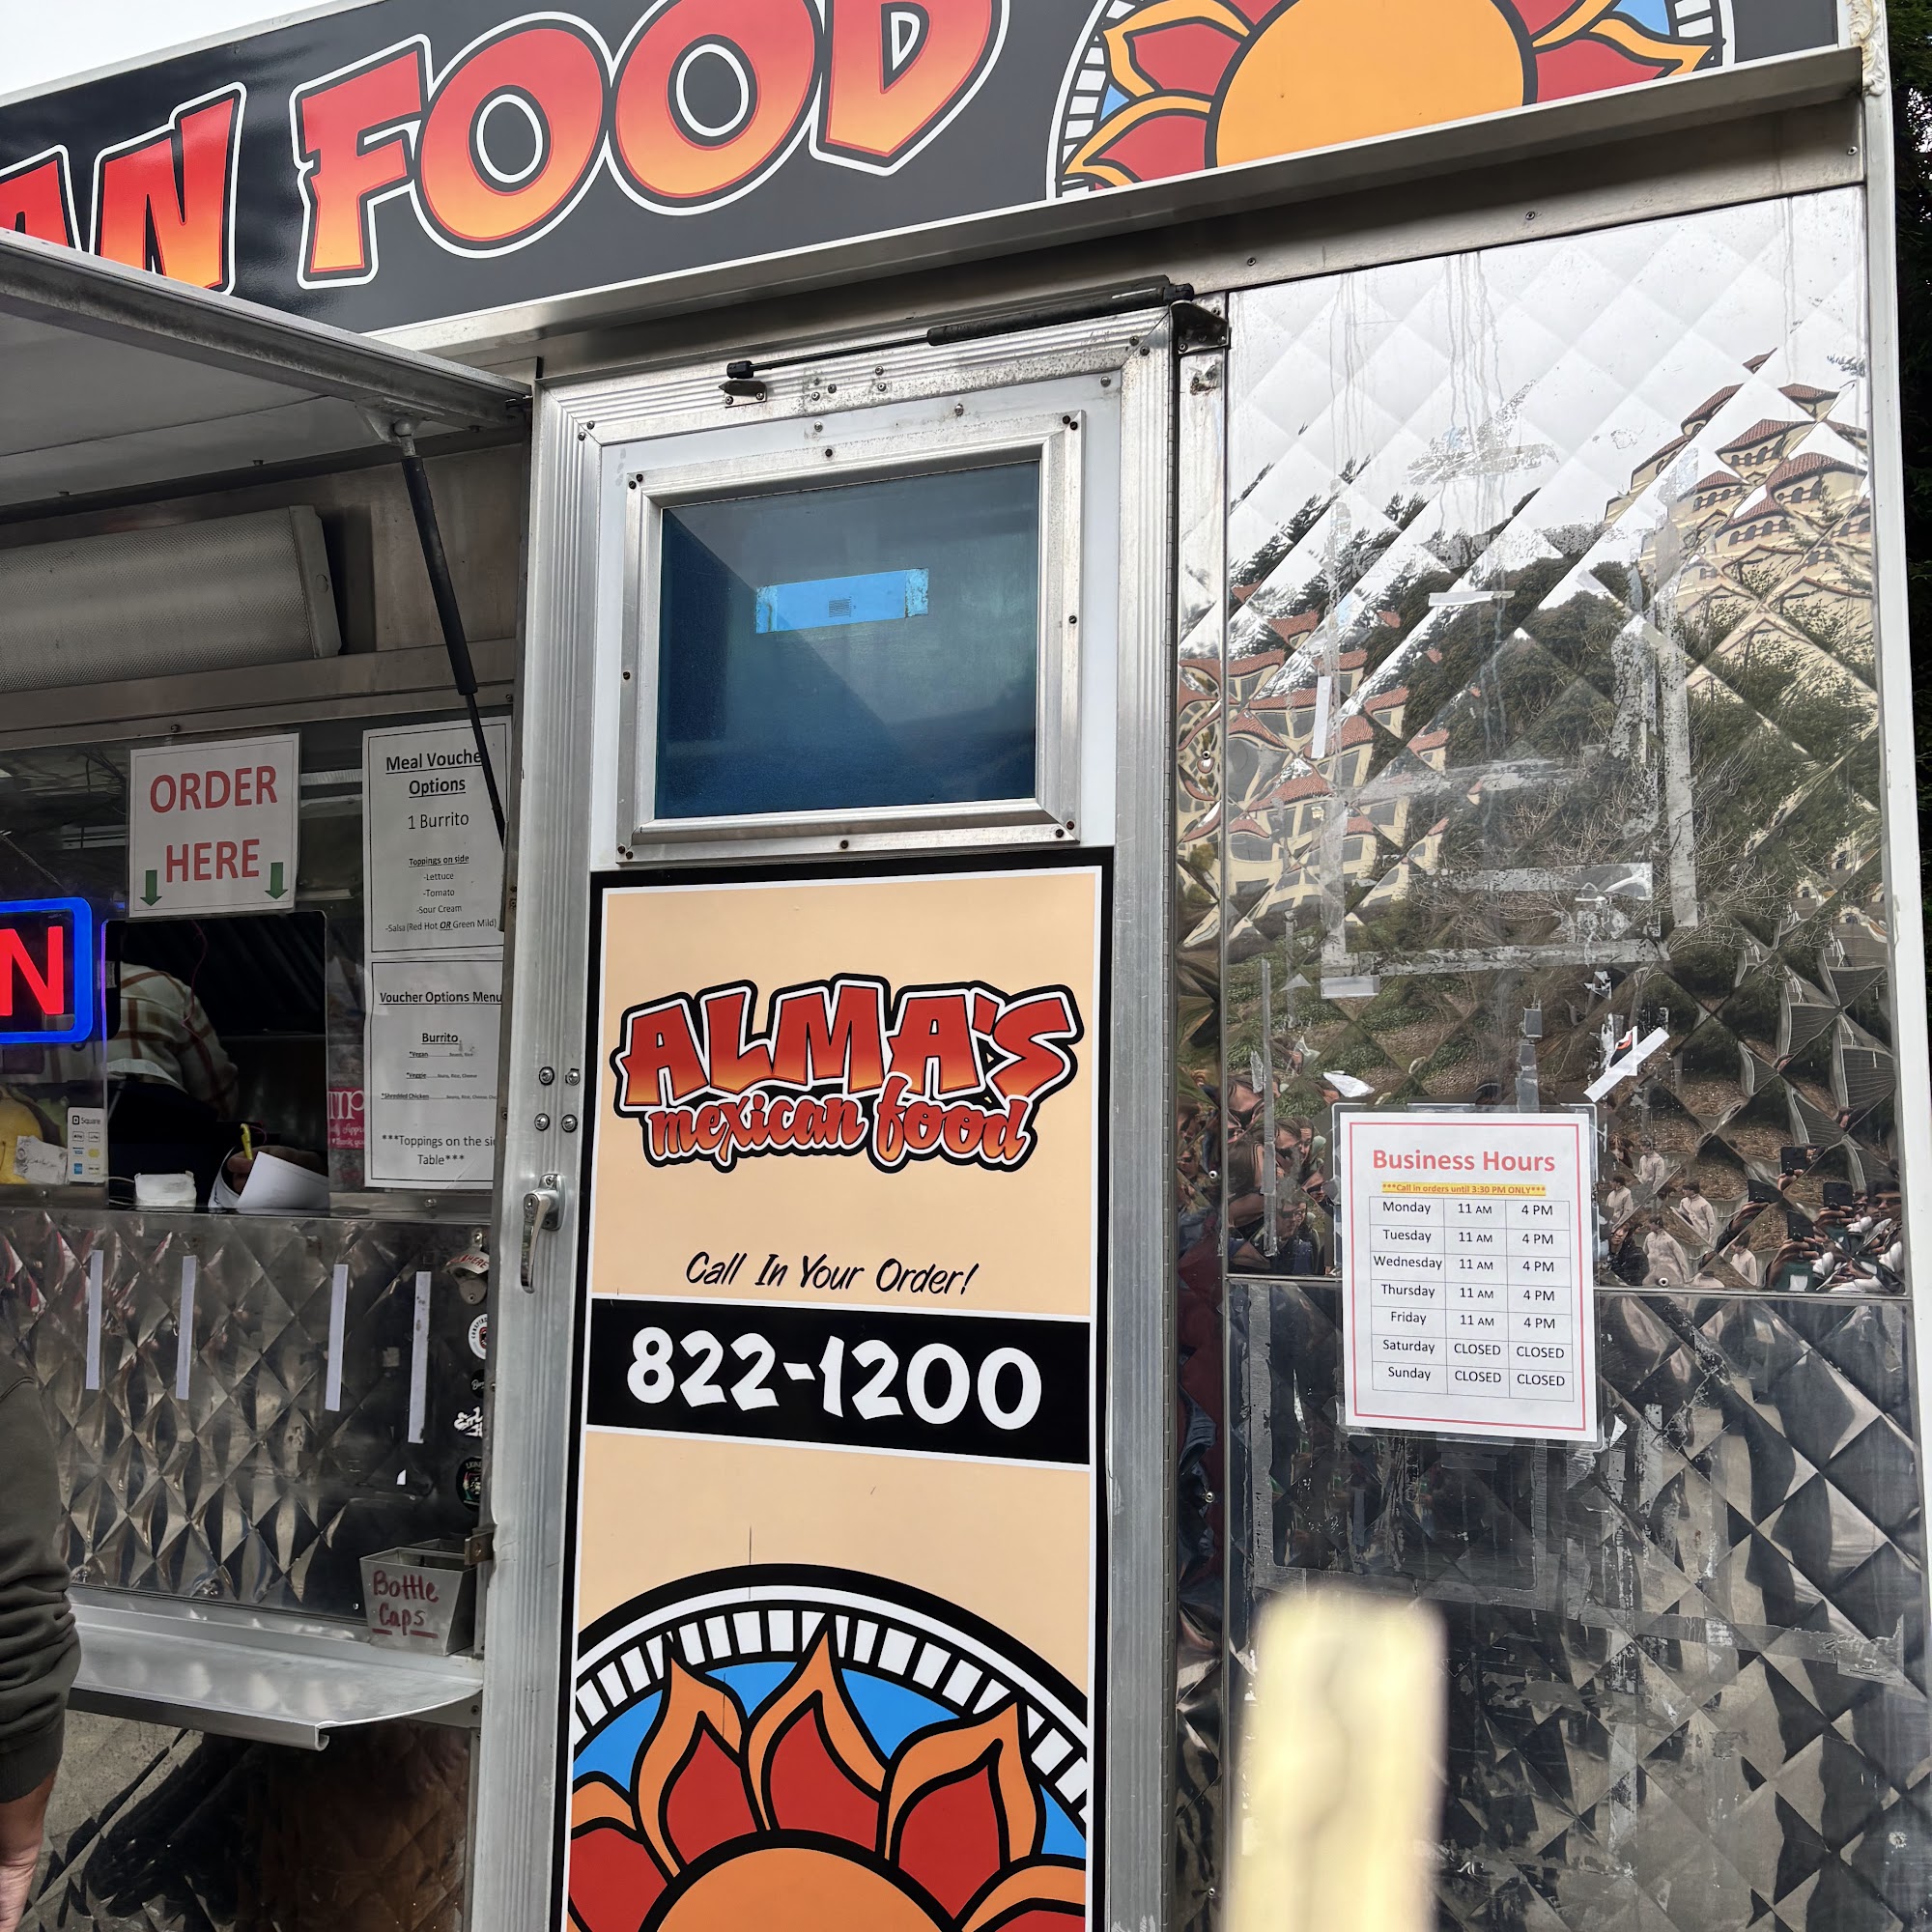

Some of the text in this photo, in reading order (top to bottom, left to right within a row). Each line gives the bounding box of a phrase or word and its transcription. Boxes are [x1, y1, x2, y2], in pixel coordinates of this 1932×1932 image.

[292, 0, 1007, 284] FOOD
[385, 748, 483, 772] Meal Vouche
[150, 765, 278, 813] ORDER
[409, 778, 467, 798] Options
[408, 811, 469, 830] 1 Burrito
[166, 838, 261, 883] HERE
[409, 854, 469, 867] Toppings on side
[423, 872, 454, 881] -Lettuce
[422, 889, 455, 897] -Tomato
[416, 904, 463, 915] -Sour Cream
[385, 918, 497, 933] -Salsa (Red Hot OR Green Mild)
[380, 991, 502, 1004] Voucher Options Menu
[422, 1032, 459, 1043] Burrito
[616, 978, 1079, 1113] ALMA'S
[645, 1071, 1032, 1167] mexican food
[464, 1136, 480, 1147] the
[1373, 1150, 1556, 1172] Business Hours
[1413, 1183, 1421, 1192] in
[1422, 1184, 1450, 1194] orders
[1451, 1185, 1470, 1194] until
[1471, 1185, 1490, 1194] 3:30
[1382, 1201, 1553, 1216] Monday 11 AM 4 PM
[1382, 1229, 1554, 1245] Tuesday 11 AM 4 PM
[1373, 1255, 1554, 1271] Wednesday 11 AM 4 PM
[684, 1251, 980, 1296] Call In Your Order!
[1380, 1284, 1555, 1301] Thursday 11 AM 4 PM
[1390, 1312, 1555, 1328] Friday 11 AM 4 PM
[1382, 1339, 1565, 1359] Saturday CLOSED CLOSED
[626, 1325, 1043, 1432] 822-1200
[1387, 1367, 1566, 1386] Sunday CLOSED CLOSED
[373, 1570, 440, 1604] Bottle
[379, 1602, 426, 1636] Caps
